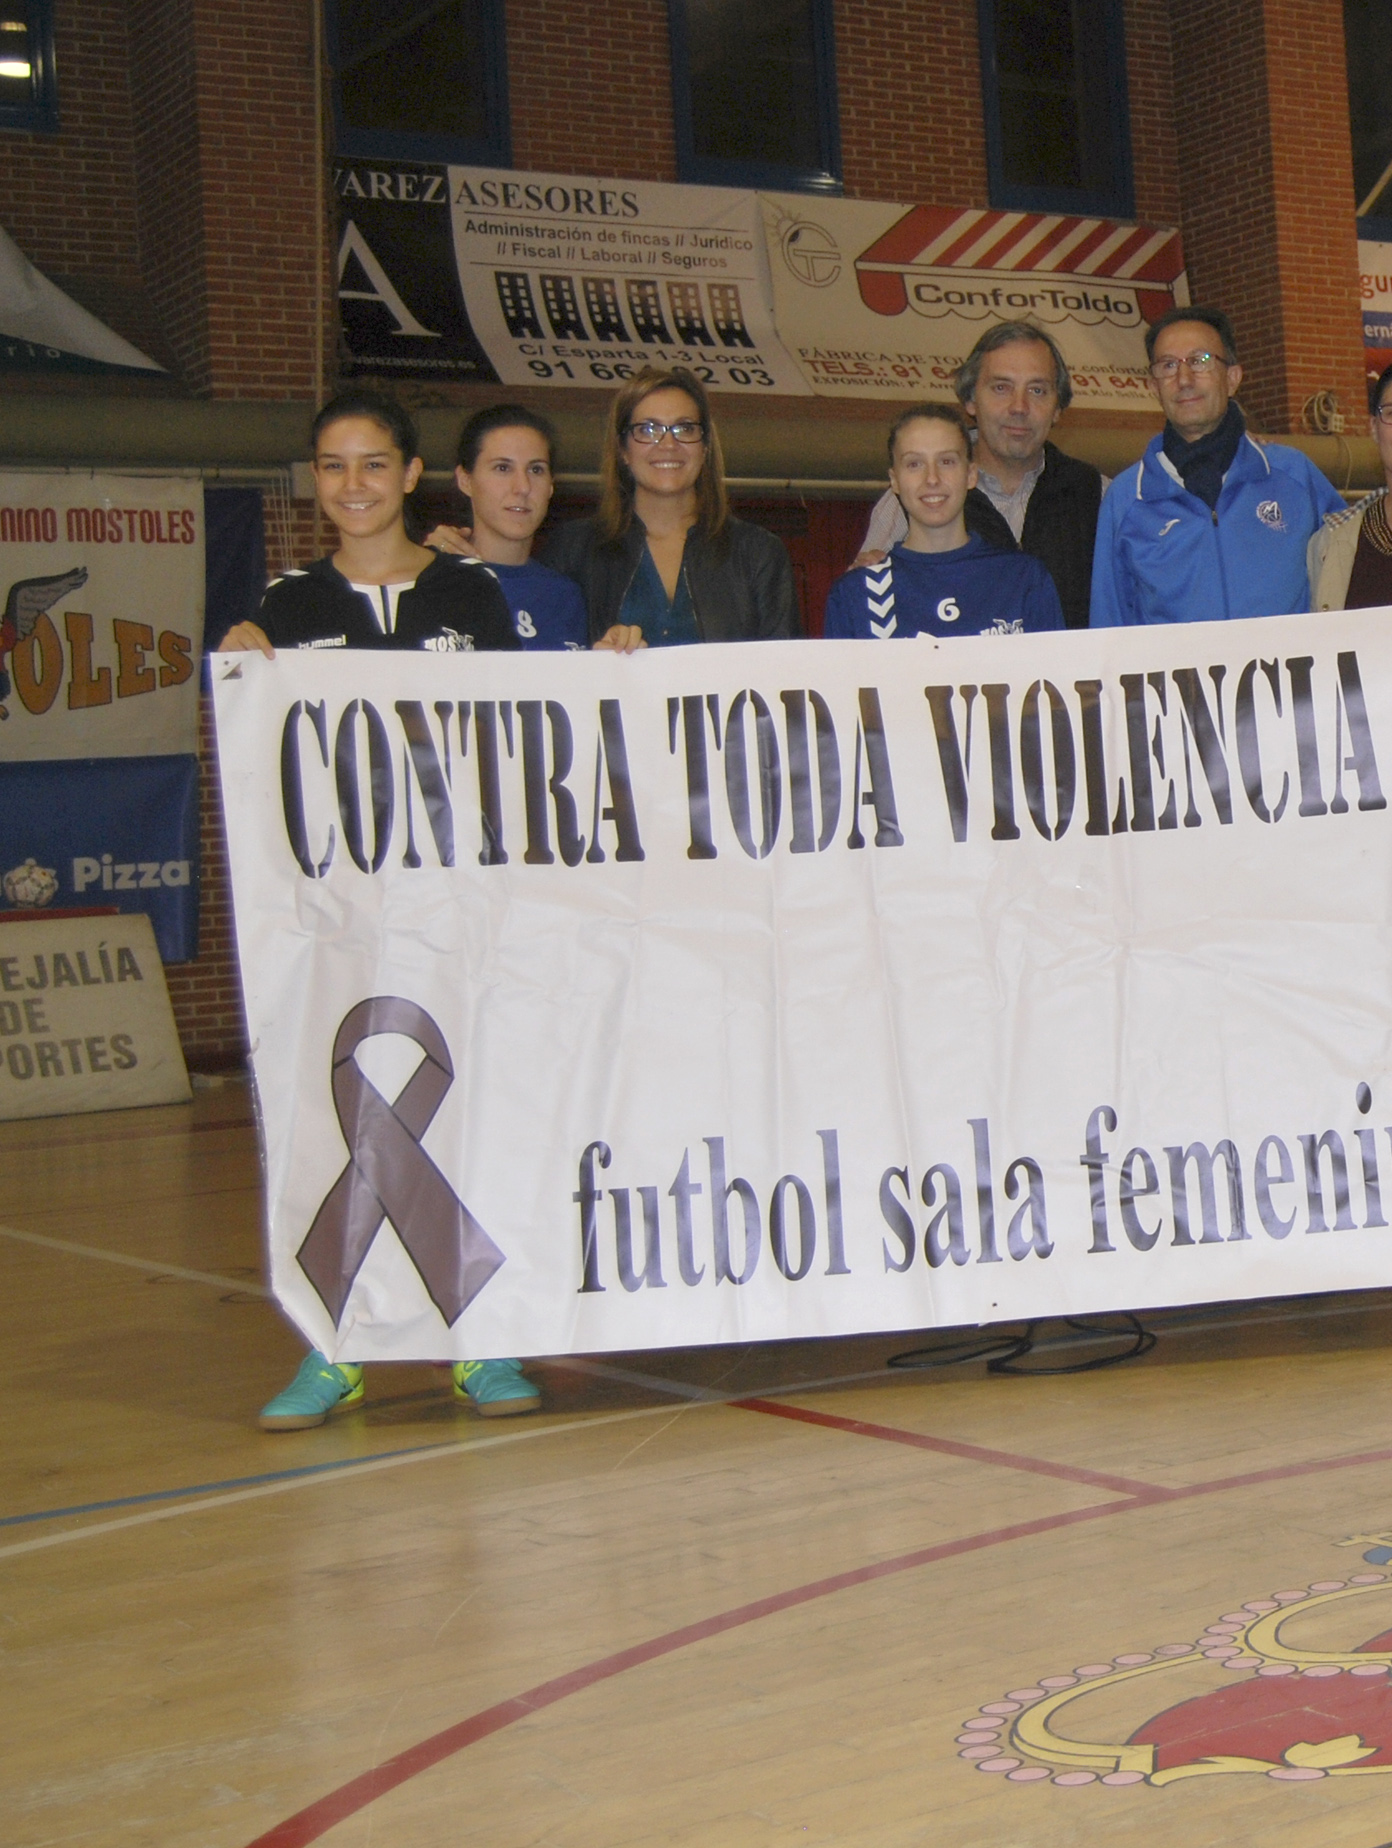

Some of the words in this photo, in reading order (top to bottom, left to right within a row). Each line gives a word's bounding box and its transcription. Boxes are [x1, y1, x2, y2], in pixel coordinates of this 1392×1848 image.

[455, 180, 640, 219] ASESORES
[465, 219, 592, 242] Administración
[597, 229, 617, 244] de
[621, 230, 670, 247] fincas
[511, 243, 561, 259] Fiscal
[581, 248, 642, 264] Laboral
[662, 251, 728, 269] Seguros
[914, 282, 1134, 316] ConforToldo
[552, 345, 650, 362] Esparta
[655, 349, 693, 363] 1-3
[698, 351, 765, 365] Local
[897, 353, 927, 366] DE
[528, 359, 575, 379] 91
[728, 367, 775, 387] 03
[891, 364, 923, 379] 91
[1072, 373, 1101, 388] 91
[937, 597, 960, 622] 6
[516, 610, 537, 638] 8
[280, 698, 647, 880] CONTRA
[666, 686, 905, 861] TODA
[924, 650, 1389, 843] VIOLENCIA
[73, 853, 190, 893] Pizza
[0, 942, 143, 993] EJALÍA
[0, 998, 50, 1037] DE
[0, 1033, 139, 1081] ORTES
[573, 1127, 852, 1294] futbol
[878, 1118, 1055, 1274] sala
